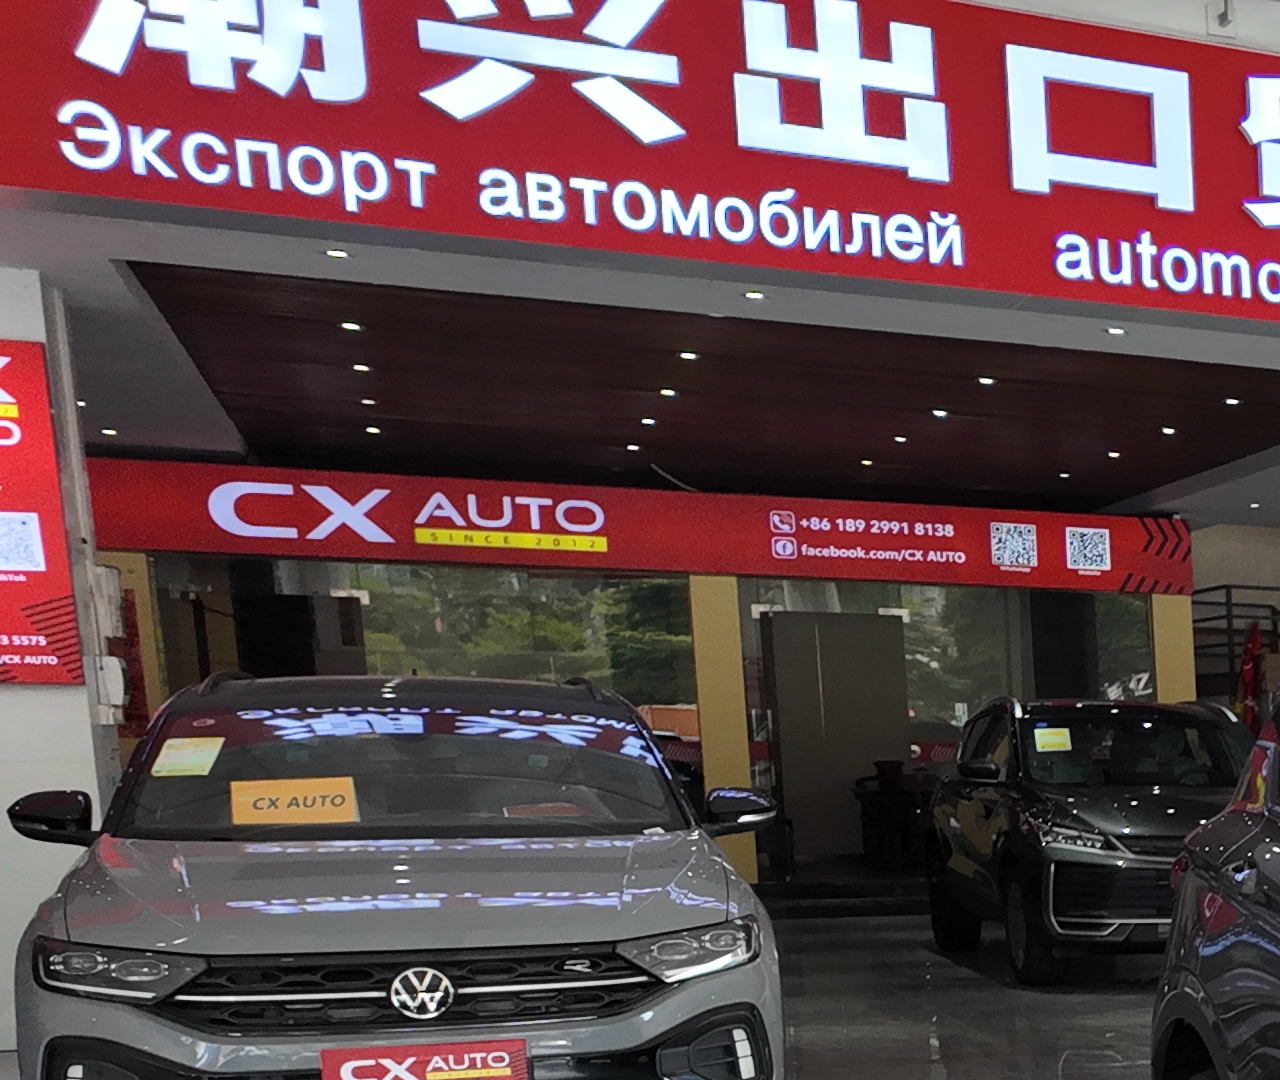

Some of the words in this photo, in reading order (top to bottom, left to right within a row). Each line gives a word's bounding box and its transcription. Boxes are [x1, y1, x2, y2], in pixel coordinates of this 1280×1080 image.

[56, 98, 437, 213] Экспорт
[478, 167, 965, 268] автомобилей
[207, 481, 397, 544] CX
[414, 491, 606, 533] AUTO
[800, 516, 831, 531] +86
[836, 518, 866, 533] 189
[870, 520, 909, 535] 2991
[914, 522, 955, 538] 8138
[430, 531, 512, 546] SINCE
[535, 536, 597, 549] 2012
[801, 544, 924, 562] facebook.com/CX
[927, 550, 967, 564] AUTO
[23, 654, 58, 666] AUTO
[252, 797, 281, 811] CX
[286, 793, 347, 809] AUTO
[426, 1051, 511, 1072] AUTO
